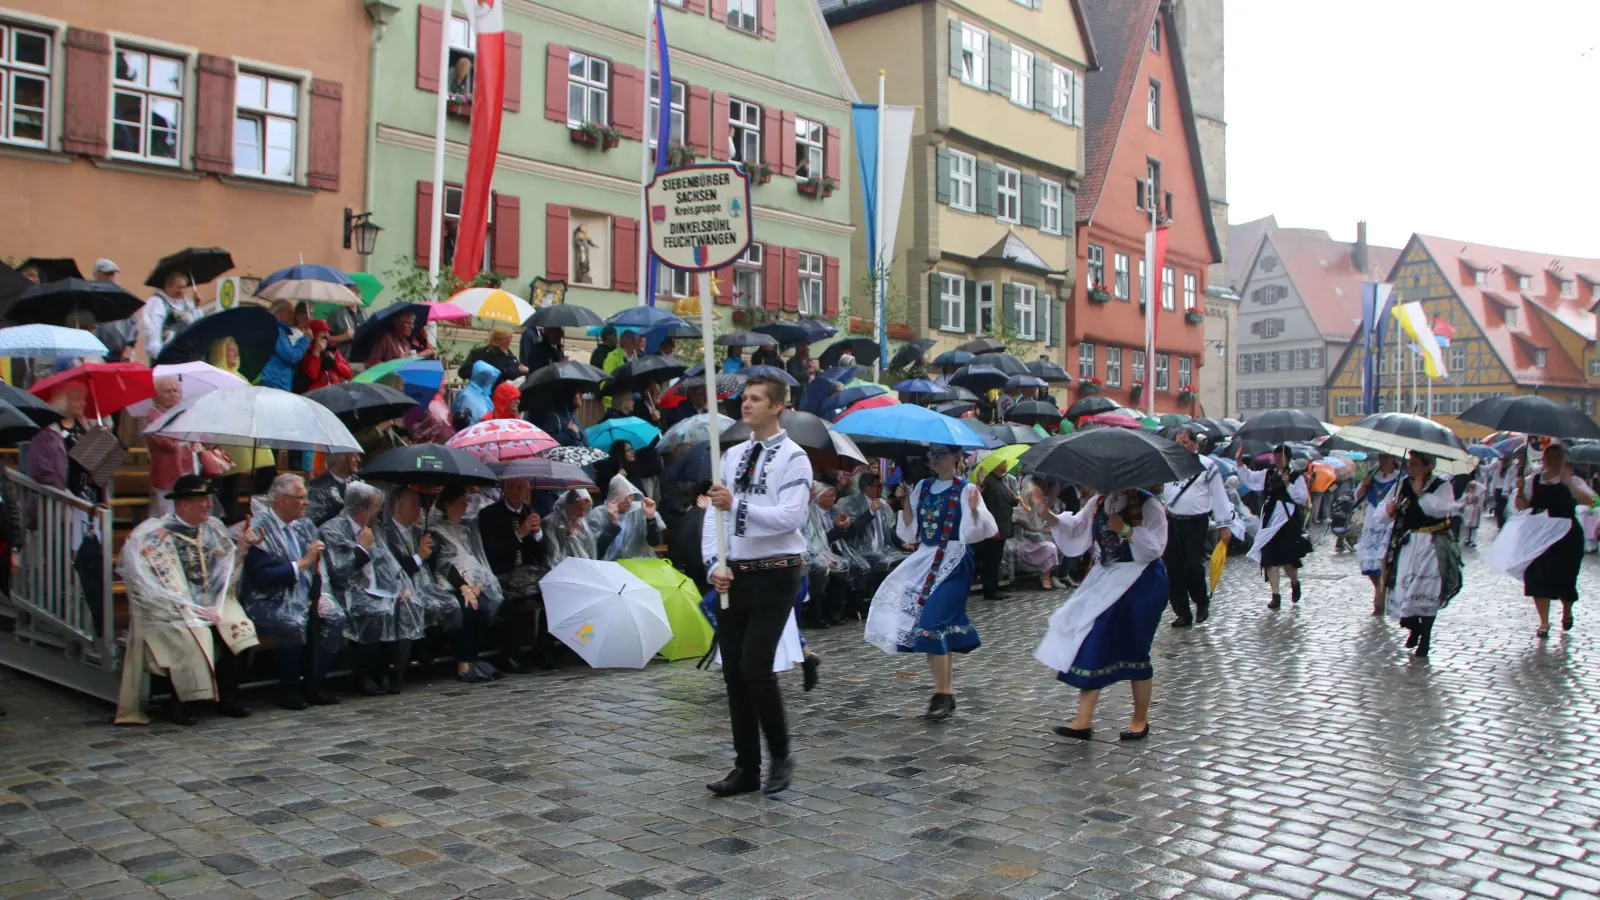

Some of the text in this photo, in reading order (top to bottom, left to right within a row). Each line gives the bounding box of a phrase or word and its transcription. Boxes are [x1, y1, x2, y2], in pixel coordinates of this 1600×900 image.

[662, 173, 730, 191] SIEBENBÜRGER
[676, 189, 717, 204] SACHSEN
[675, 204, 721, 216] Kreisgruppe
[670, 217, 731, 235] DINKELSBÜHL
[663, 232, 736, 248] FEUCHTWANGEN
